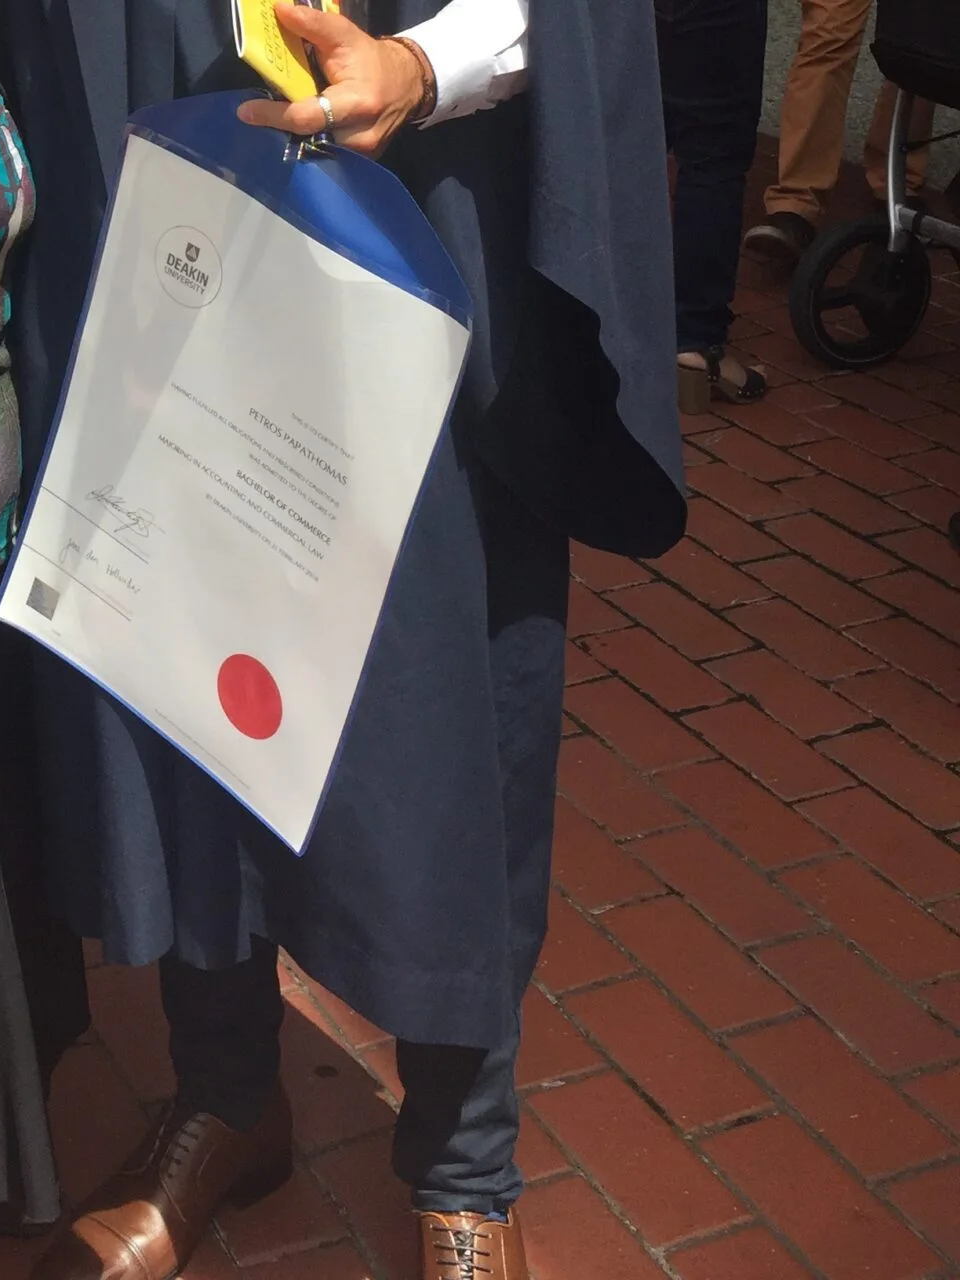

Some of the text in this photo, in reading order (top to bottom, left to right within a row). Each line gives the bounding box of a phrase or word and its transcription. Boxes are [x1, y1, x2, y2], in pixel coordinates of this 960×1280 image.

[164, 266, 205, 295] UNIVERSITY
[166, 252, 209, 287] DEAKIN
[192, 397, 218, 418] FULFILLED
[218, 415, 227, 425] ALL
[227, 422, 262, 450] OBLIGATIONS
[249, 407, 348, 486] PETROS PAPATHOMAS
[158, 433, 325, 561] MAJORING IN ACCOUNTING AND COMMERCIAL LAW
[235, 469, 333, 547] BACHELOR OF COMMERCE
[288, 482, 297, 492] TO
